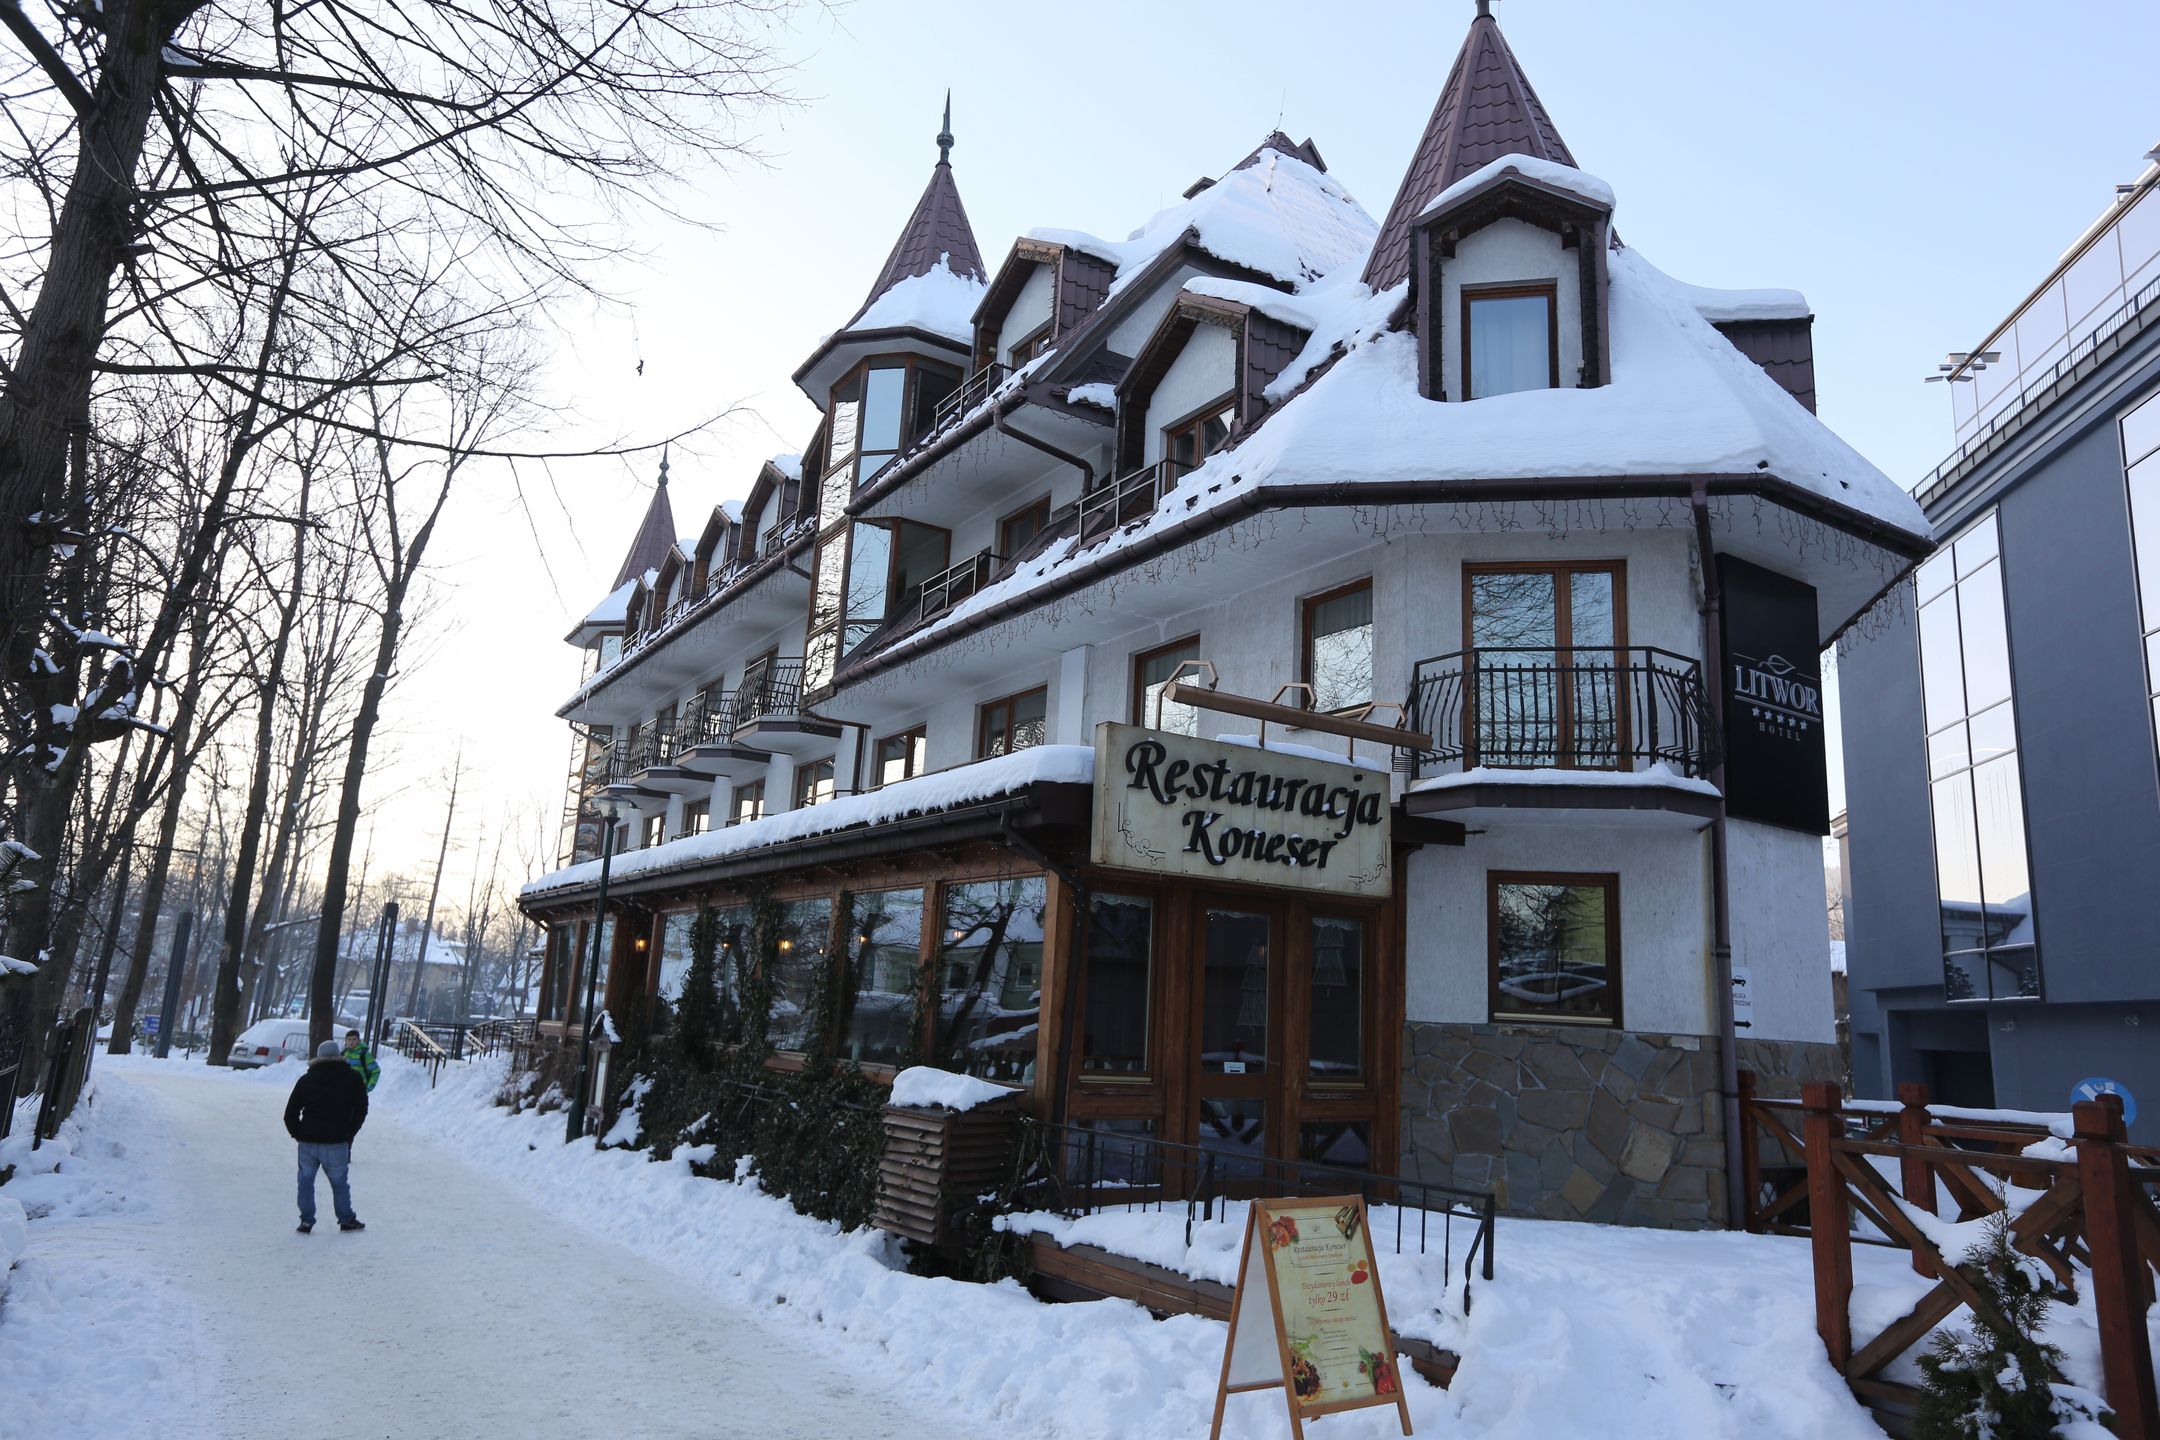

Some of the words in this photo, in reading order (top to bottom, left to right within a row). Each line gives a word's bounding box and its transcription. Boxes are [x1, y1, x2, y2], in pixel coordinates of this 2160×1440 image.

[1734, 664, 1820, 715] LITWOR
[1759, 721, 1801, 741] HOTEL
[1125, 740, 1382, 839] Restauracja
[1182, 810, 1338, 869] Koneser
[1327, 1291, 1338, 1303] 29
[1340, 1289, 1350, 1301] zł
